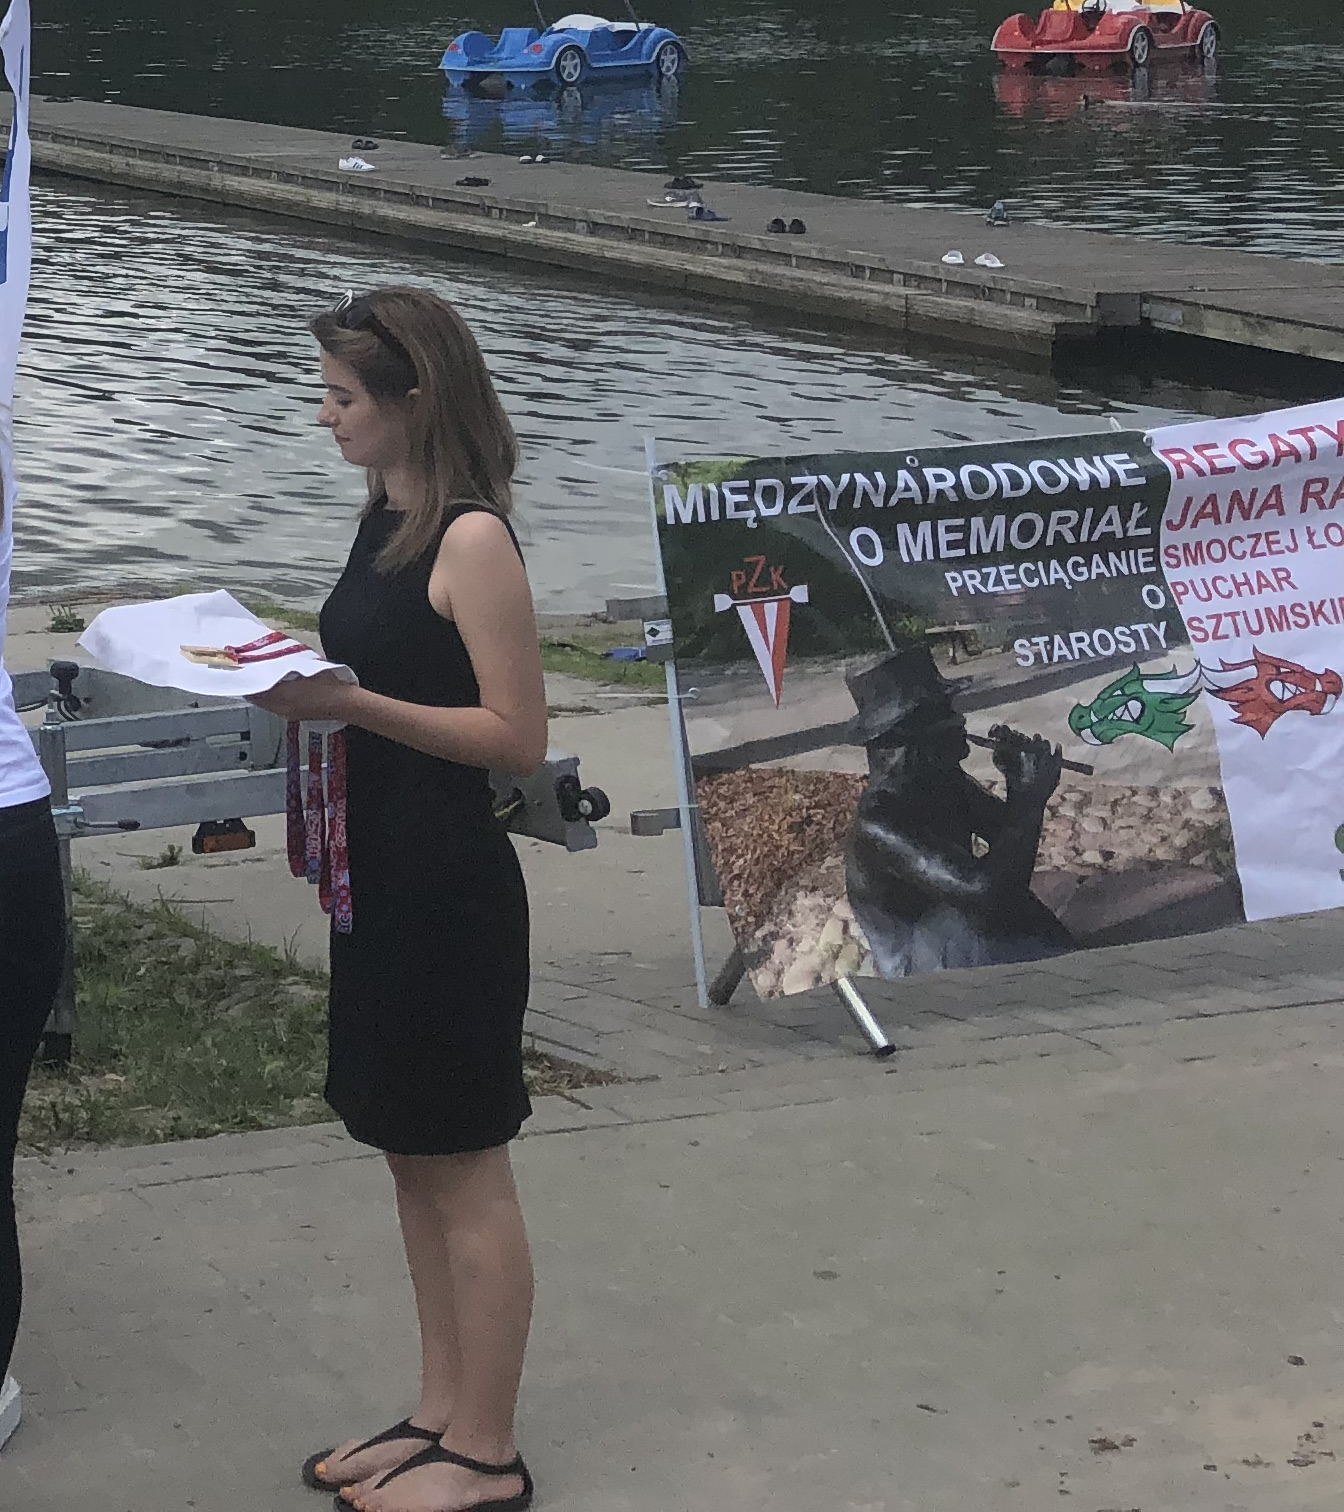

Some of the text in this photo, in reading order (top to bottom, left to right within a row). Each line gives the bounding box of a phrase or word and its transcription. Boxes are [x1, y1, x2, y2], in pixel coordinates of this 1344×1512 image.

[662, 418, 1344, 529] MIĘDZYNARODOWE REGATY
[849, 525, 885, 568] O
[896, 501, 1153, 564] MEMORIAŁ
[1165, 482, 1286, 533] JANA
[729, 554, 789, 594] PZK
[944, 547, 1157, 598] PRZECIĄGANIE
[1163, 527, 1299, 570] SMOCZEJ
[1141, 566, 1299, 611] O PUCHAR
[1013, 620, 1168, 668] STAROSTY
